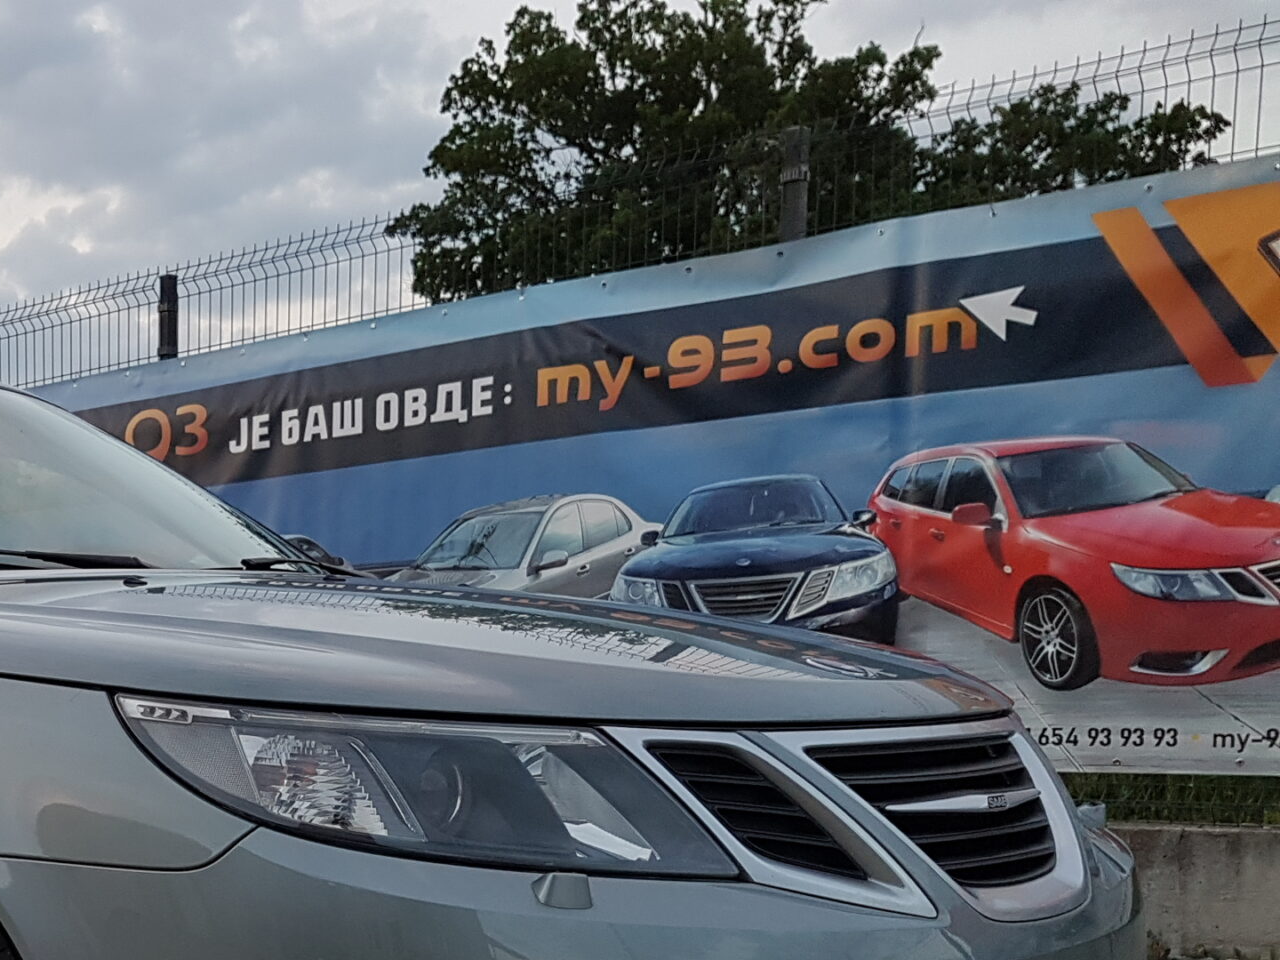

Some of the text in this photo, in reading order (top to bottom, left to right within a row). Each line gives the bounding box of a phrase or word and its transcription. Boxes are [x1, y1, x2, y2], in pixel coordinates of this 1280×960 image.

[536, 306, 978, 411] my-93.com
[1038, 727, 1079, 747] 654
[1087, 727, 1112, 747] 93
[1120, 727, 1145, 747] 93
[1153, 727, 1179, 747] 93
